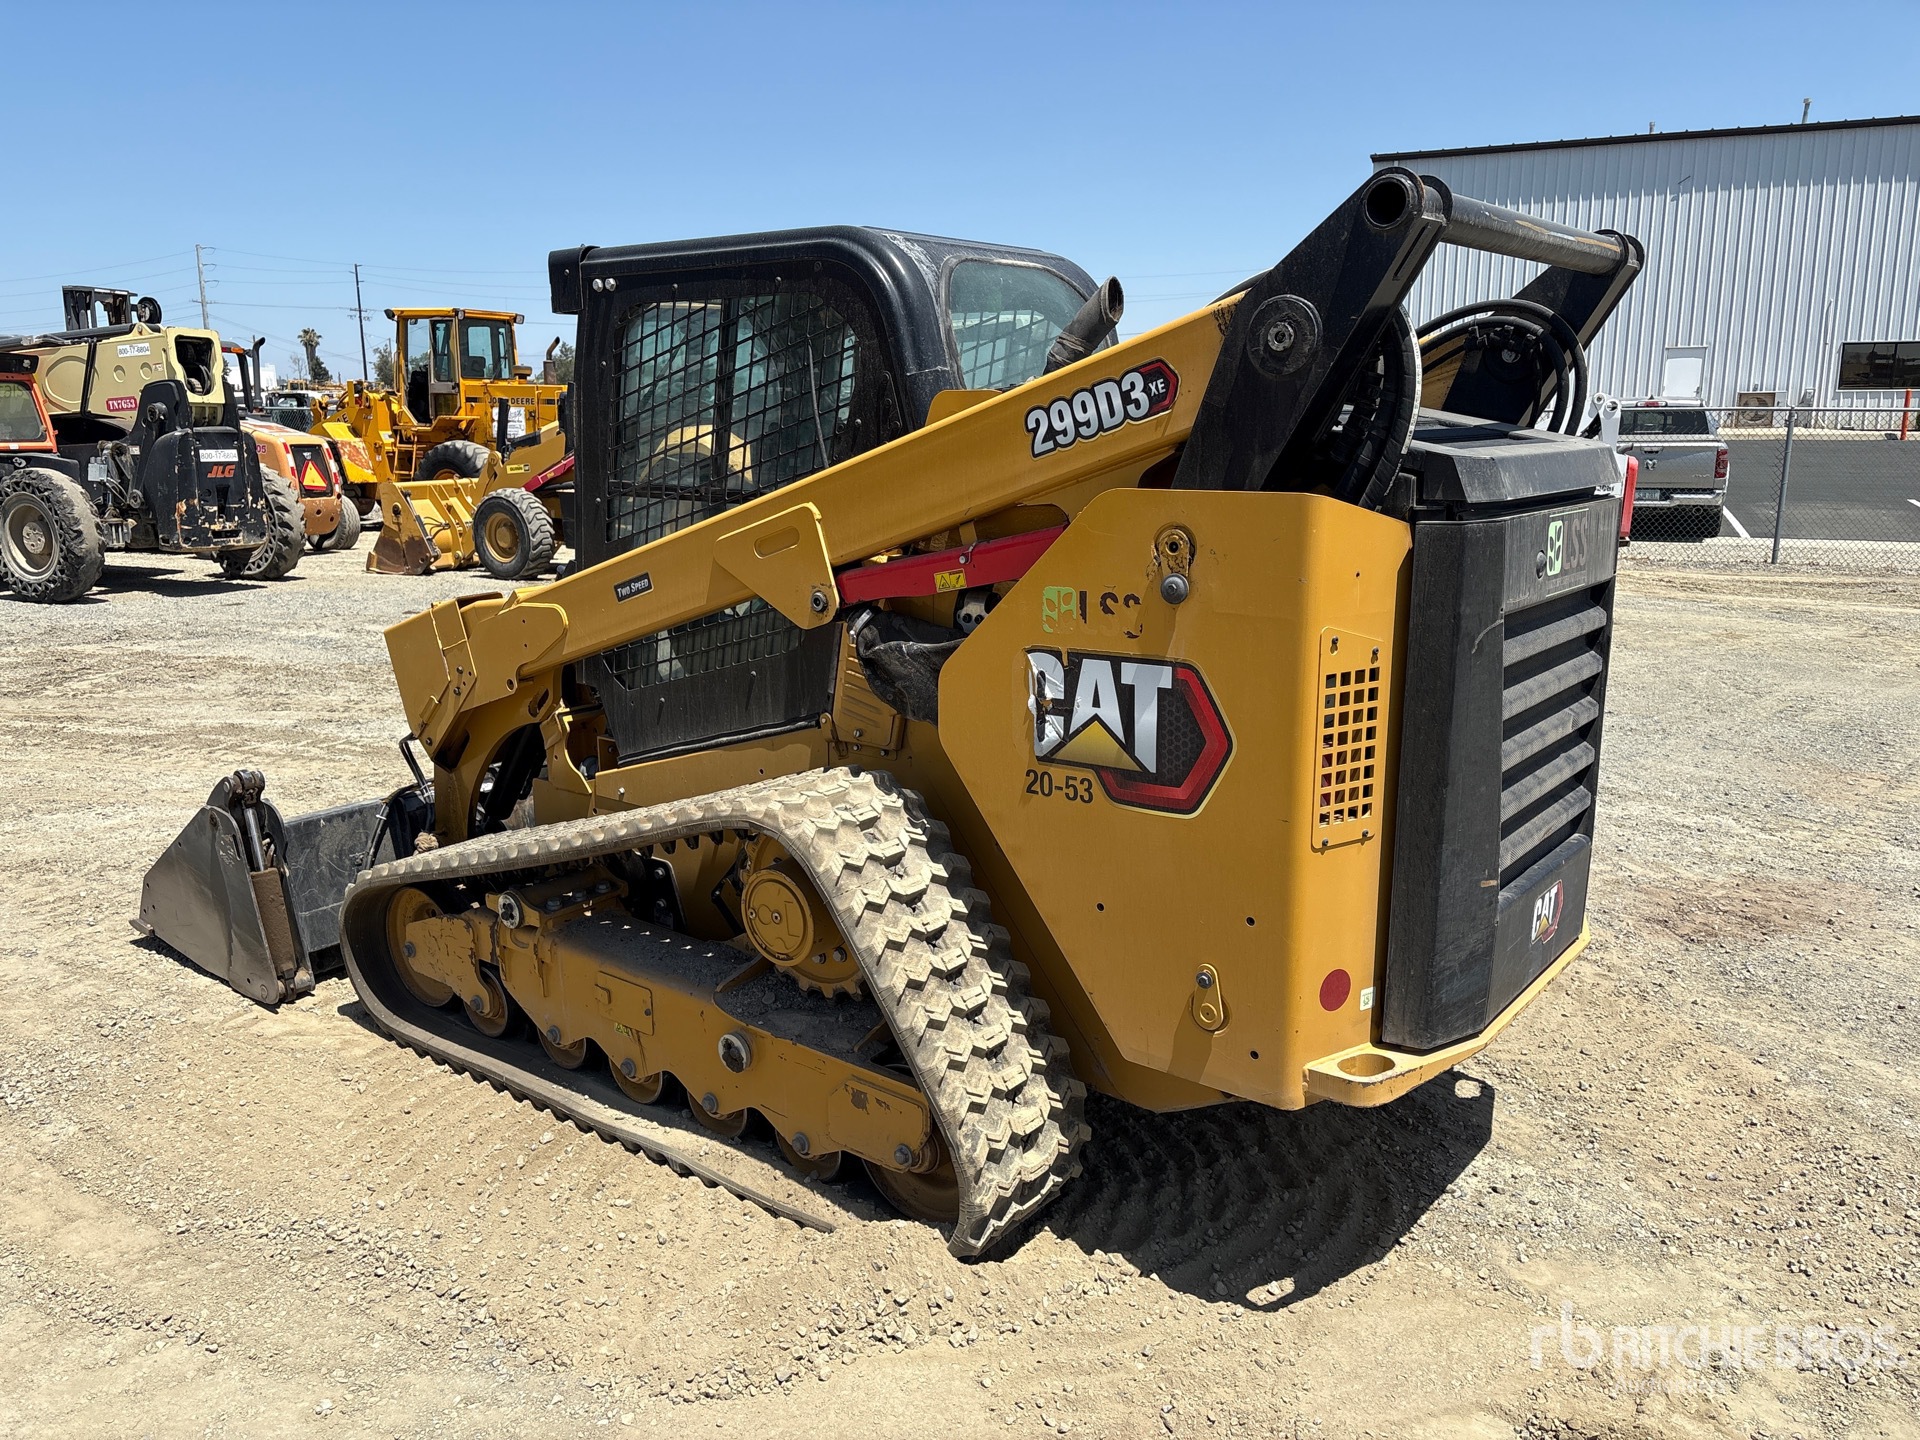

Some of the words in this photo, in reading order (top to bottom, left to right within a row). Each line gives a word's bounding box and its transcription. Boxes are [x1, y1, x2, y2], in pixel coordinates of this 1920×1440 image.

[510, 397, 535, 405] DEERE
[1027, 371, 1150, 455] 299D3
[1149, 378, 1167, 397] XE
[207, 464, 236, 478] JLG
[1563, 516, 1588, 570] LSS
[1027, 651, 1173, 773] CAT
[1025, 768, 1094, 804] 20-53
[1531, 884, 1558, 941] CAT
